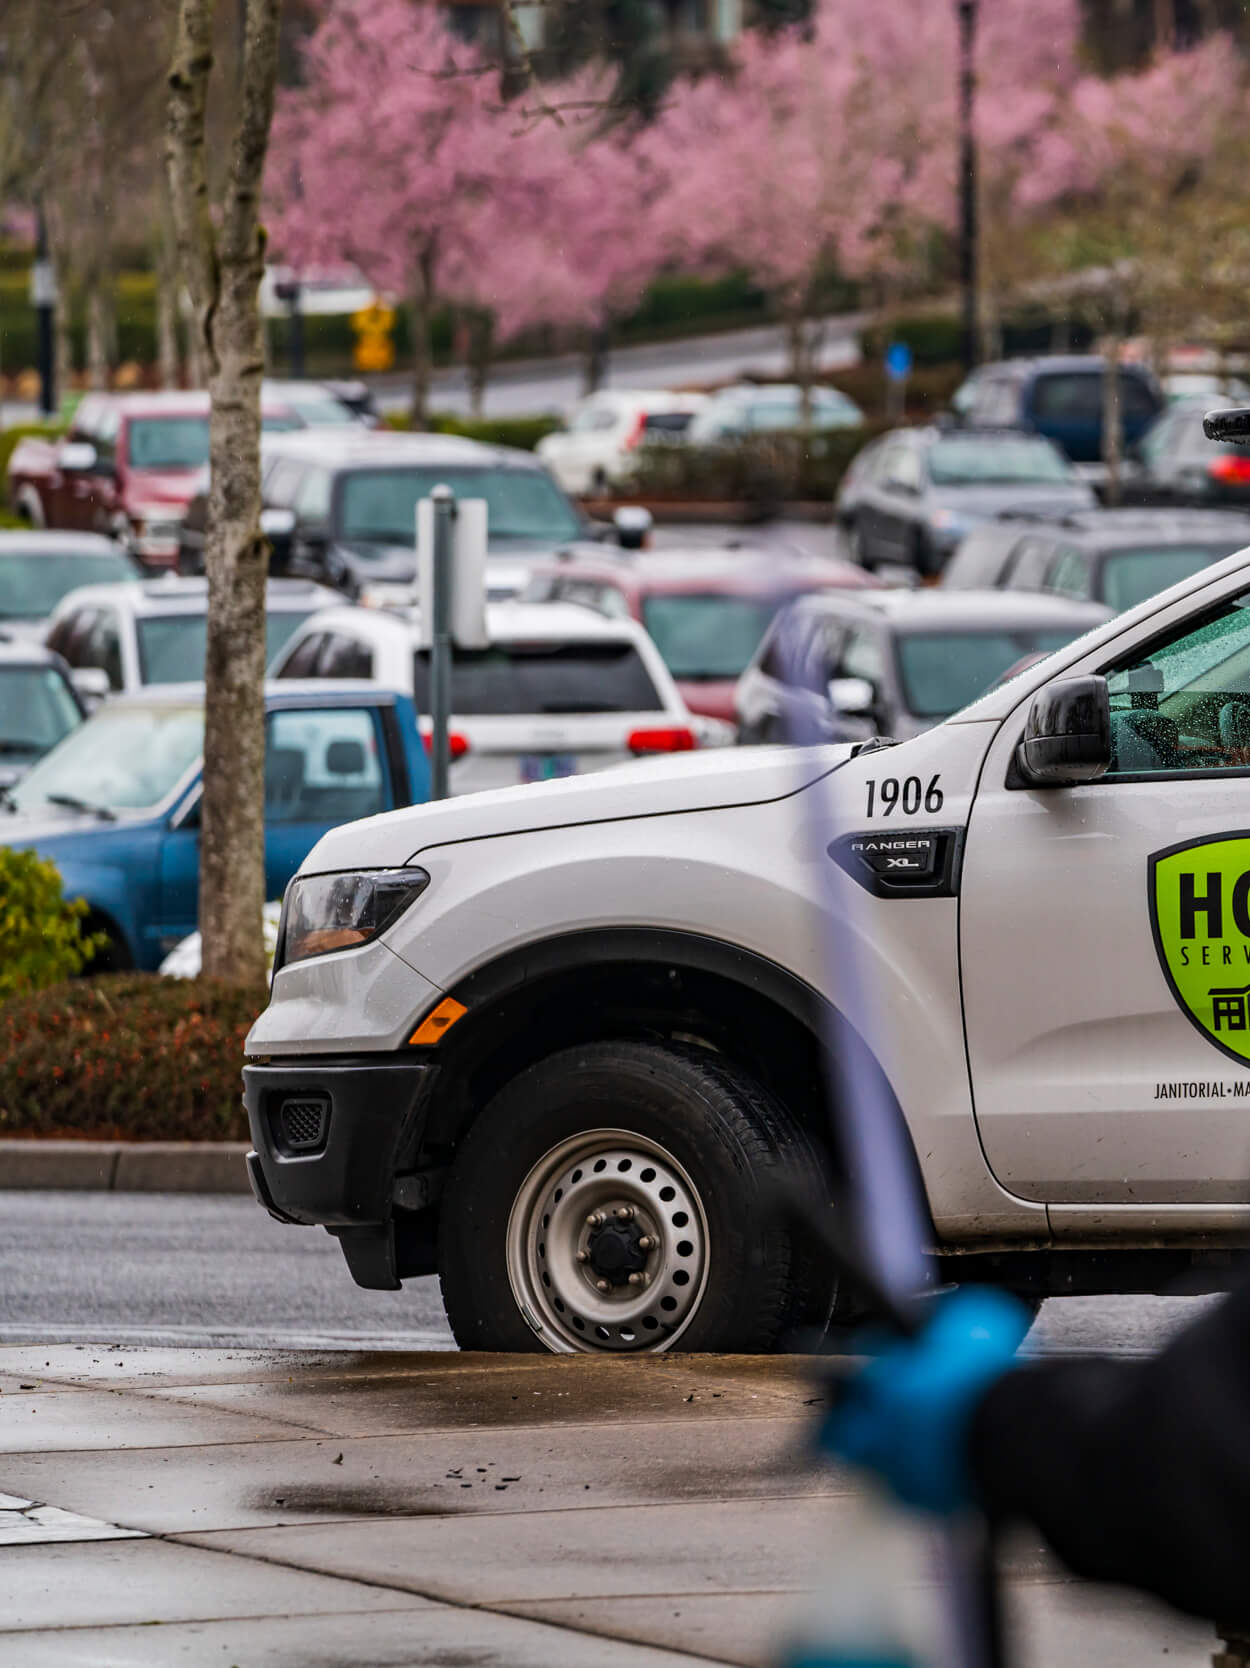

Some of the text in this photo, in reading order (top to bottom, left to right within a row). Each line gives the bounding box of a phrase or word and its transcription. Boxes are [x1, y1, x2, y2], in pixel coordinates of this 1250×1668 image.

[865, 774, 944, 818] 1906
[851, 840, 930, 851] RANGER
[887, 858, 919, 868] XL
